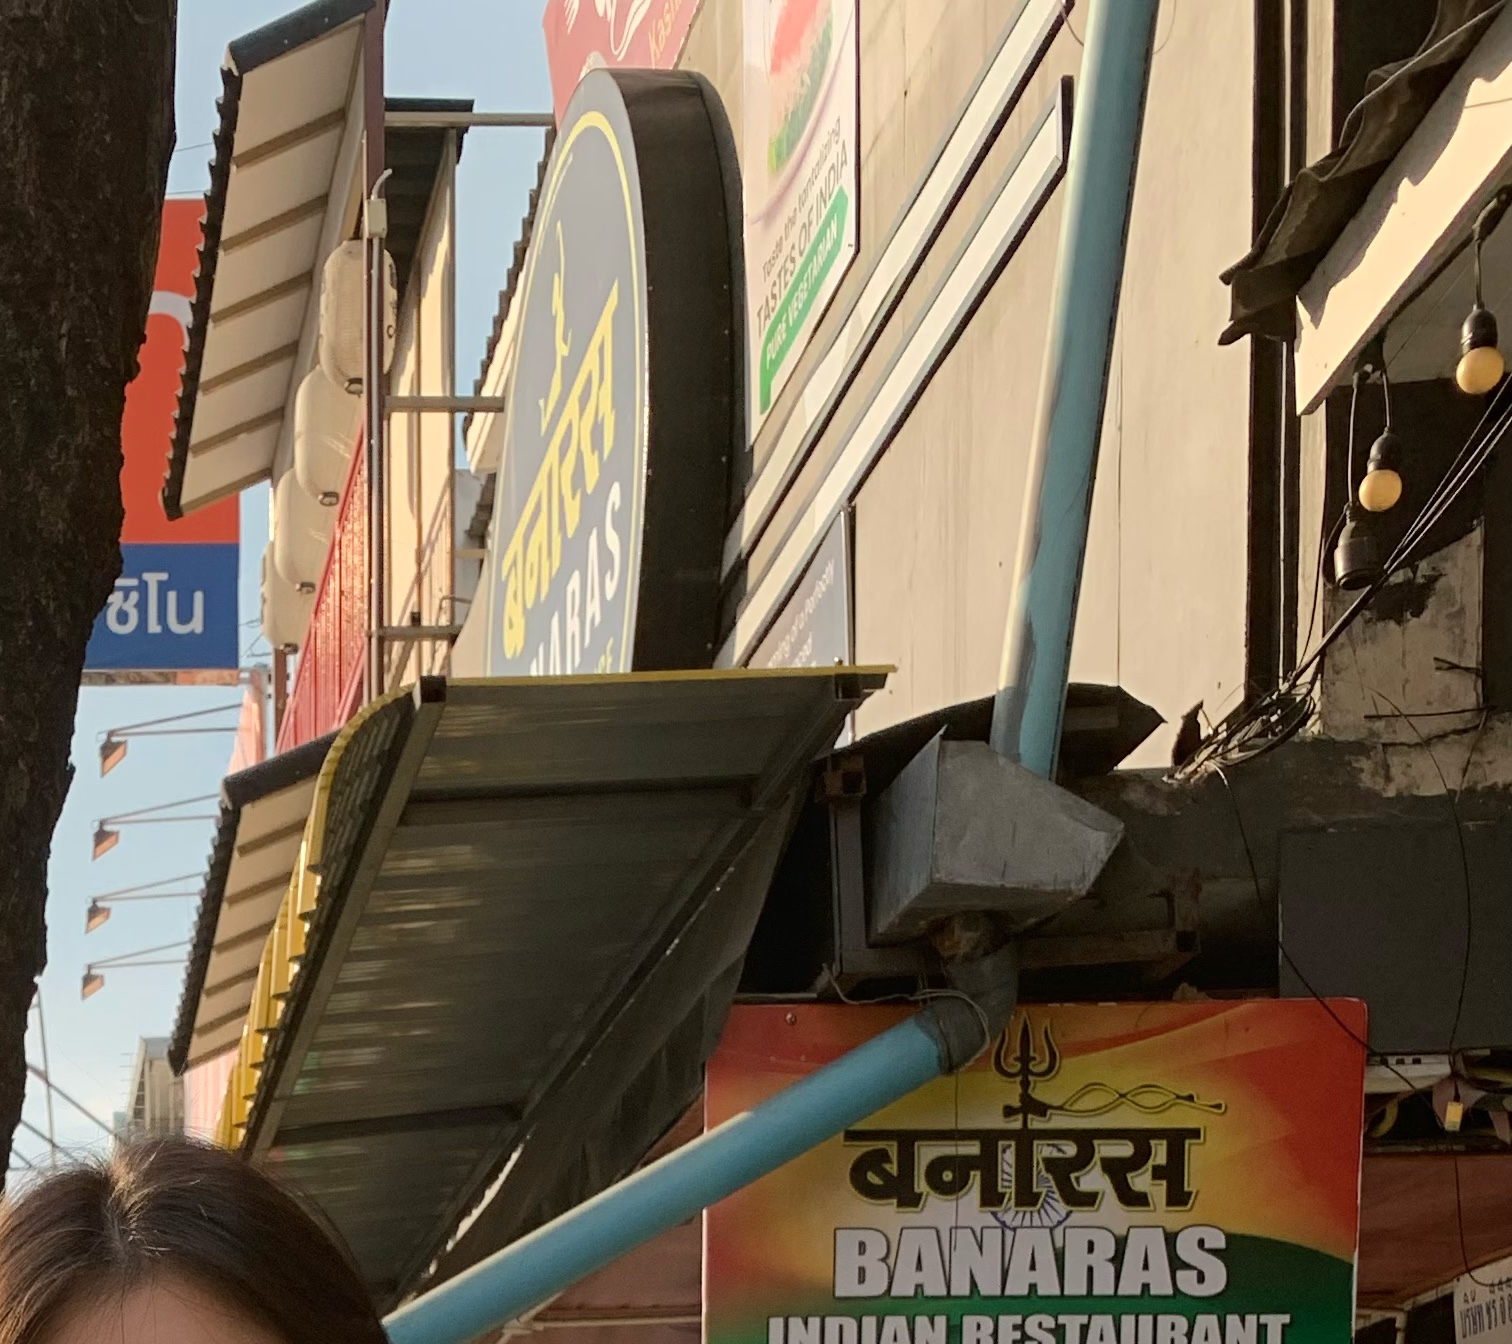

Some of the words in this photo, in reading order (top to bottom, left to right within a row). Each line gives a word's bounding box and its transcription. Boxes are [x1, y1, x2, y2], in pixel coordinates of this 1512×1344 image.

[756, 256, 796, 338] TASTES
[798, 217, 813, 258] OF
[814, 138, 848, 234] INDIA
[762, 232, 784, 284] Taste
[766, 307, 787, 370] PURE
[788, 213, 838, 328] VEGETARIAN
[502, 277, 618, 660] बनारस
[843, 1126, 1205, 1211] बनारस
[833, 1225, 1228, 1299] BANARAS
